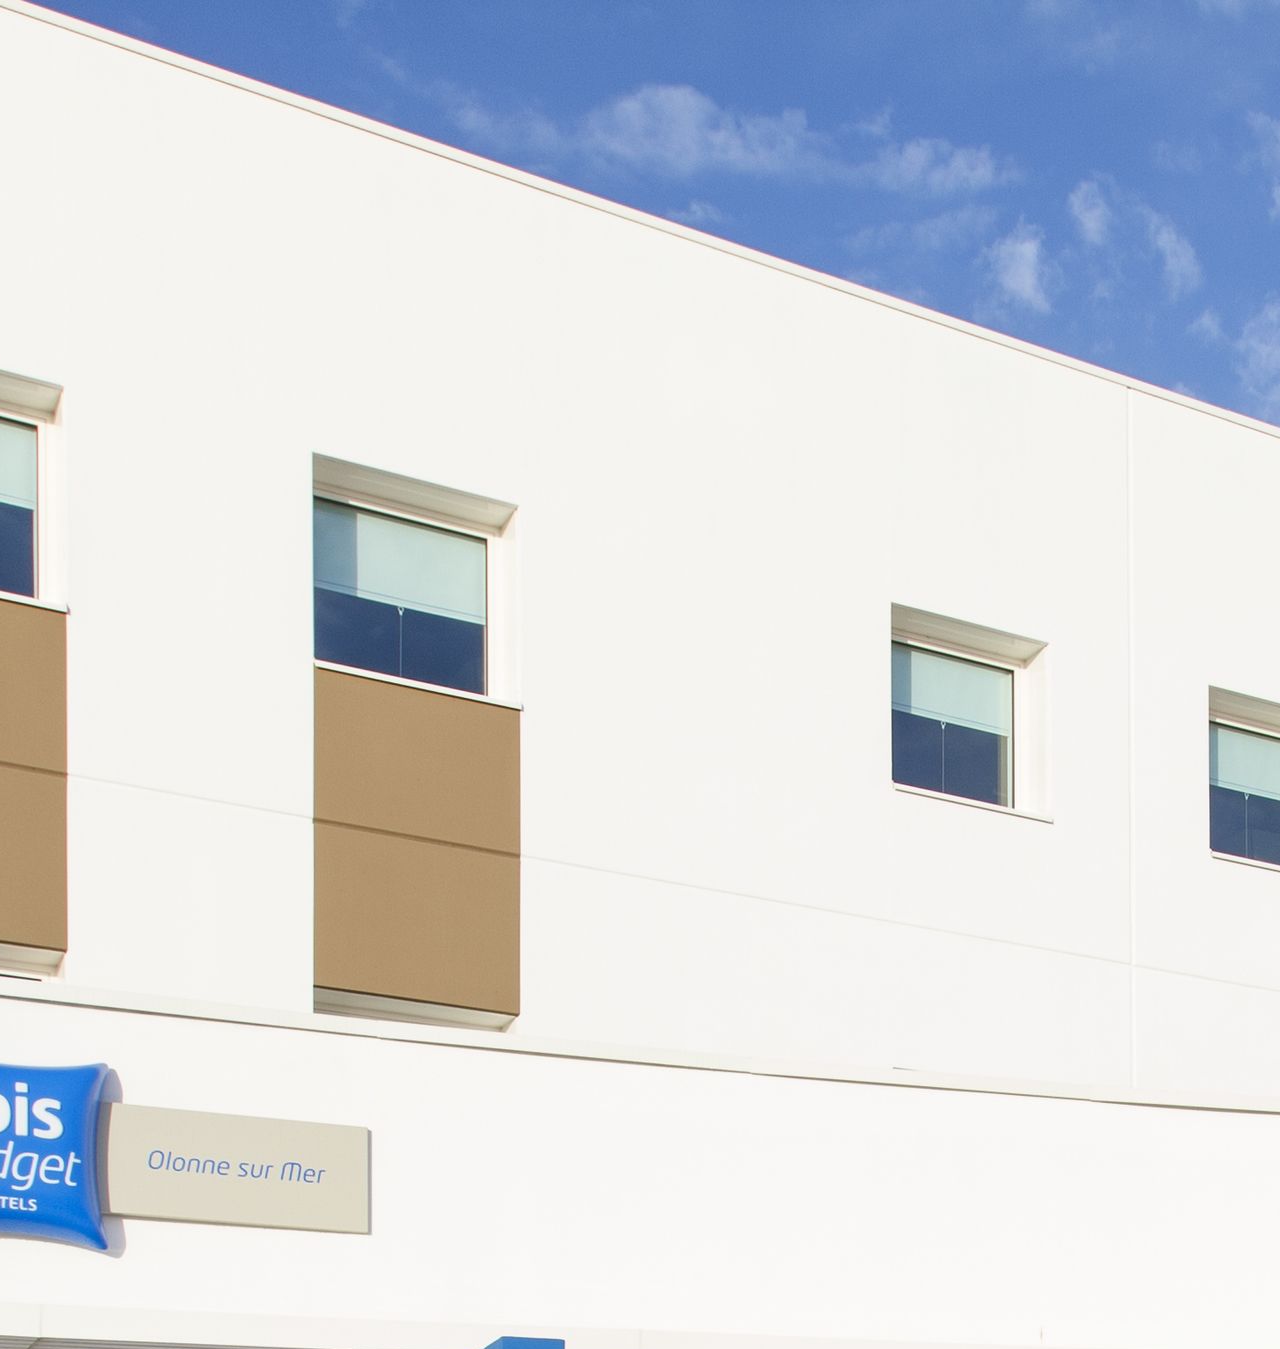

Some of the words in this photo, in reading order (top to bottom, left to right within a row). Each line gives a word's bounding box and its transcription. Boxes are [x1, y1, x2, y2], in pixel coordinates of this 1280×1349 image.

[148, 1150, 230, 1176] Olonne
[238, 1162, 274, 1179] sur
[280, 1161, 326, 1184] Mer
